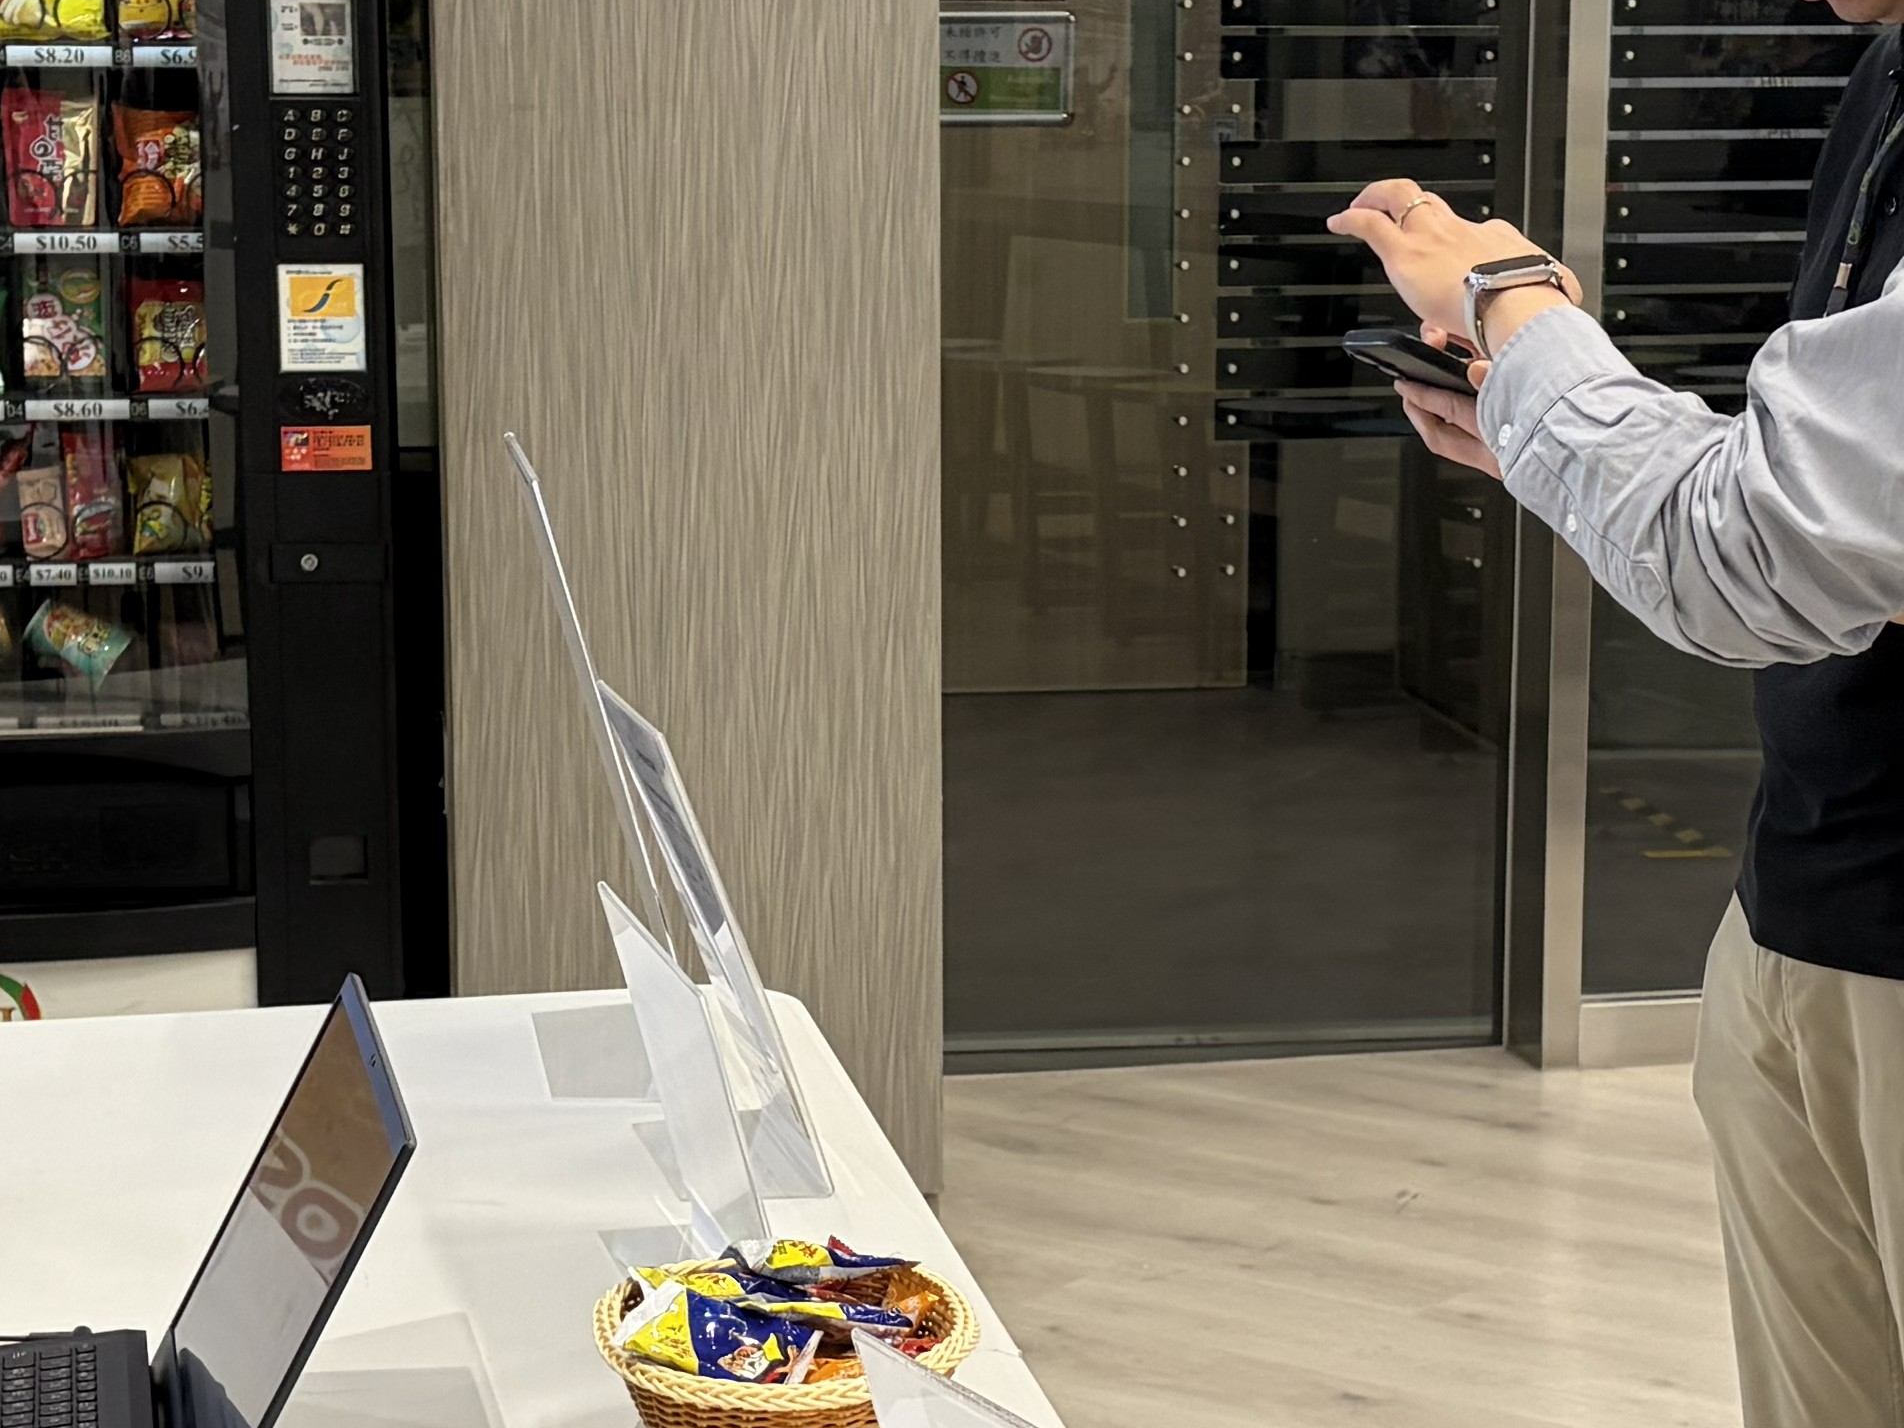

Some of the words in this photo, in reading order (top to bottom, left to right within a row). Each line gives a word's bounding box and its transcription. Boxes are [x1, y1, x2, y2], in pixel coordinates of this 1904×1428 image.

[34, 49, 84, 65] $8.20
[160, 50, 196, 65] $6.9
[36, 236, 96, 251] $10.50
[168, 236, 203, 250] $5.5
[53, 402, 103, 417] $8.60
[176, 402, 209, 416] $6.
[36, 569, 72, 581] $7.40
